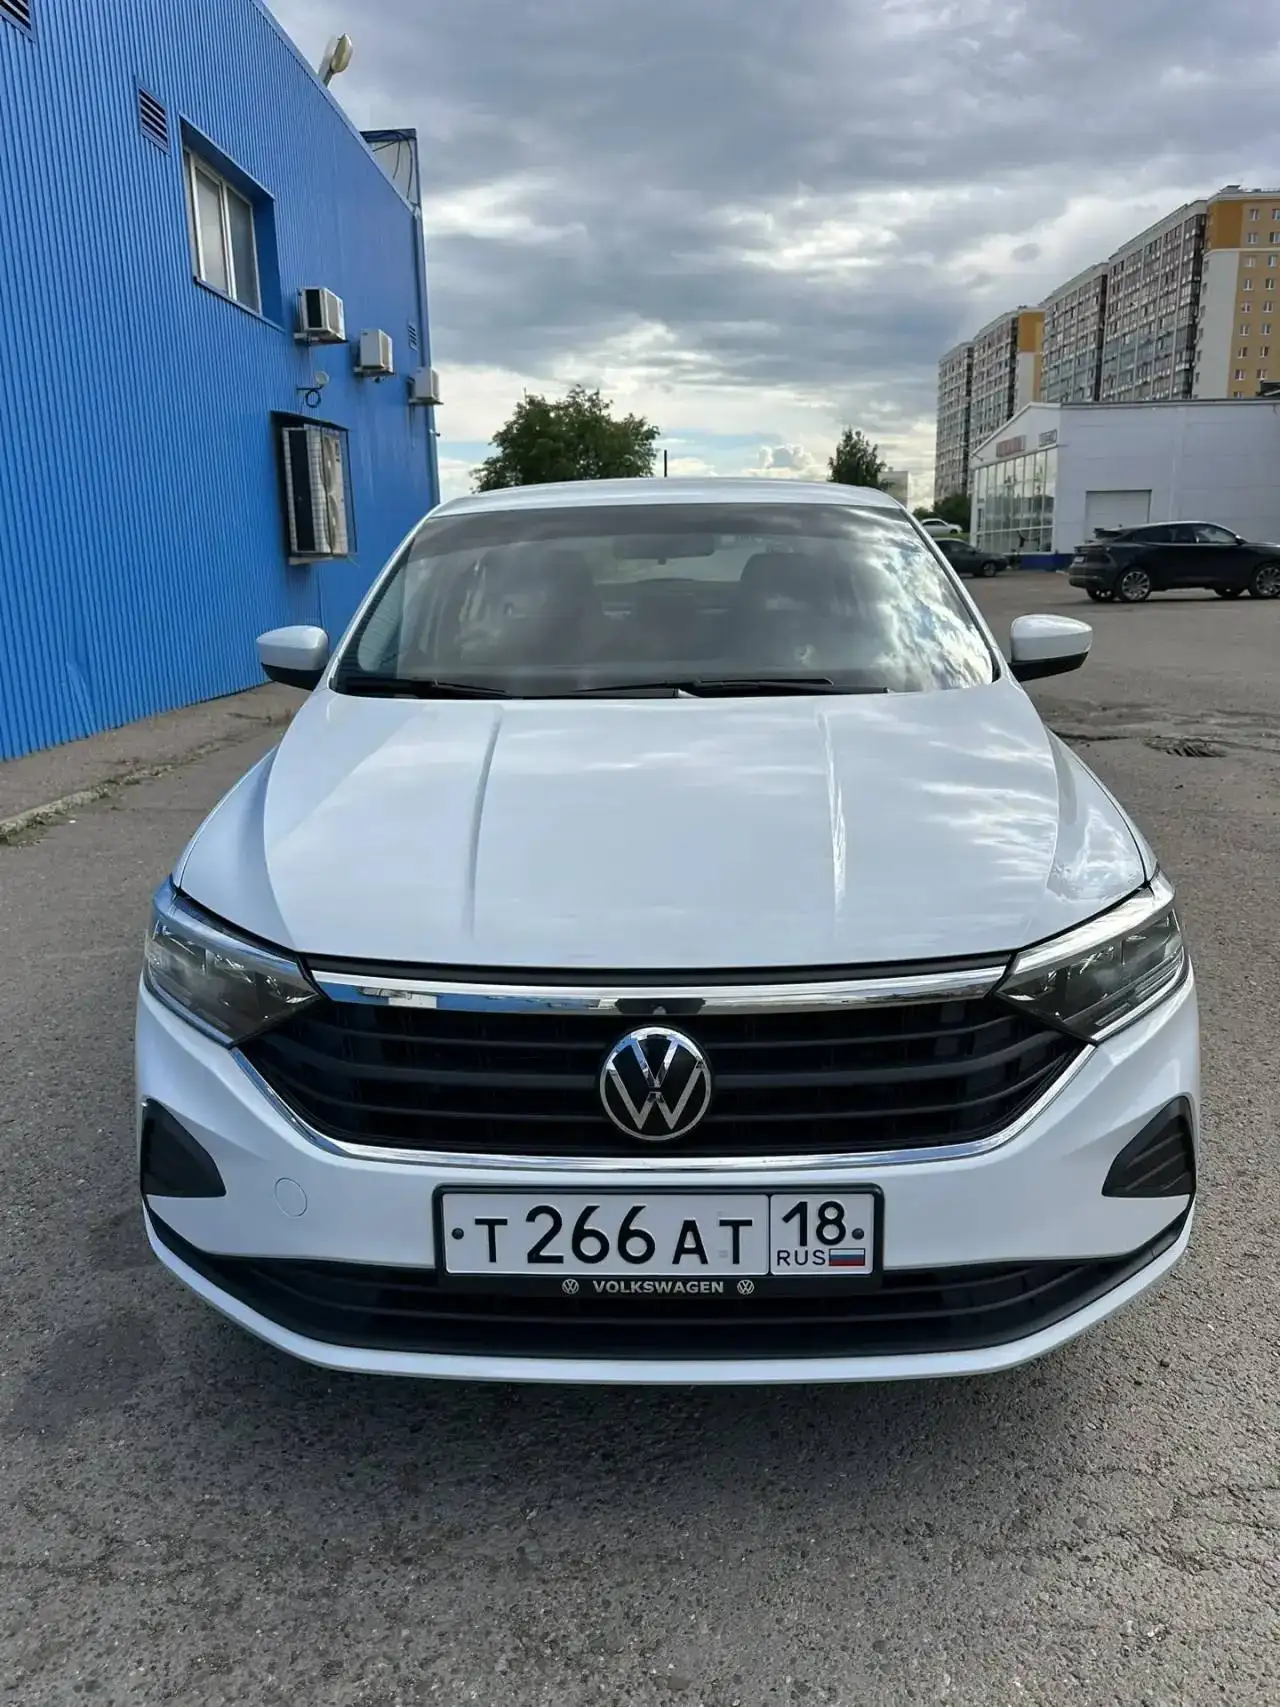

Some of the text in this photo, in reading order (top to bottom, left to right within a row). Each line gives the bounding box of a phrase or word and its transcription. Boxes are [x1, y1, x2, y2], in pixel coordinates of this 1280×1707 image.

[782, 1201, 847, 1247] 18
[776, 1249, 826, 1266] RUS
[593, 1279, 724, 1294] VOLKSWAGEN
